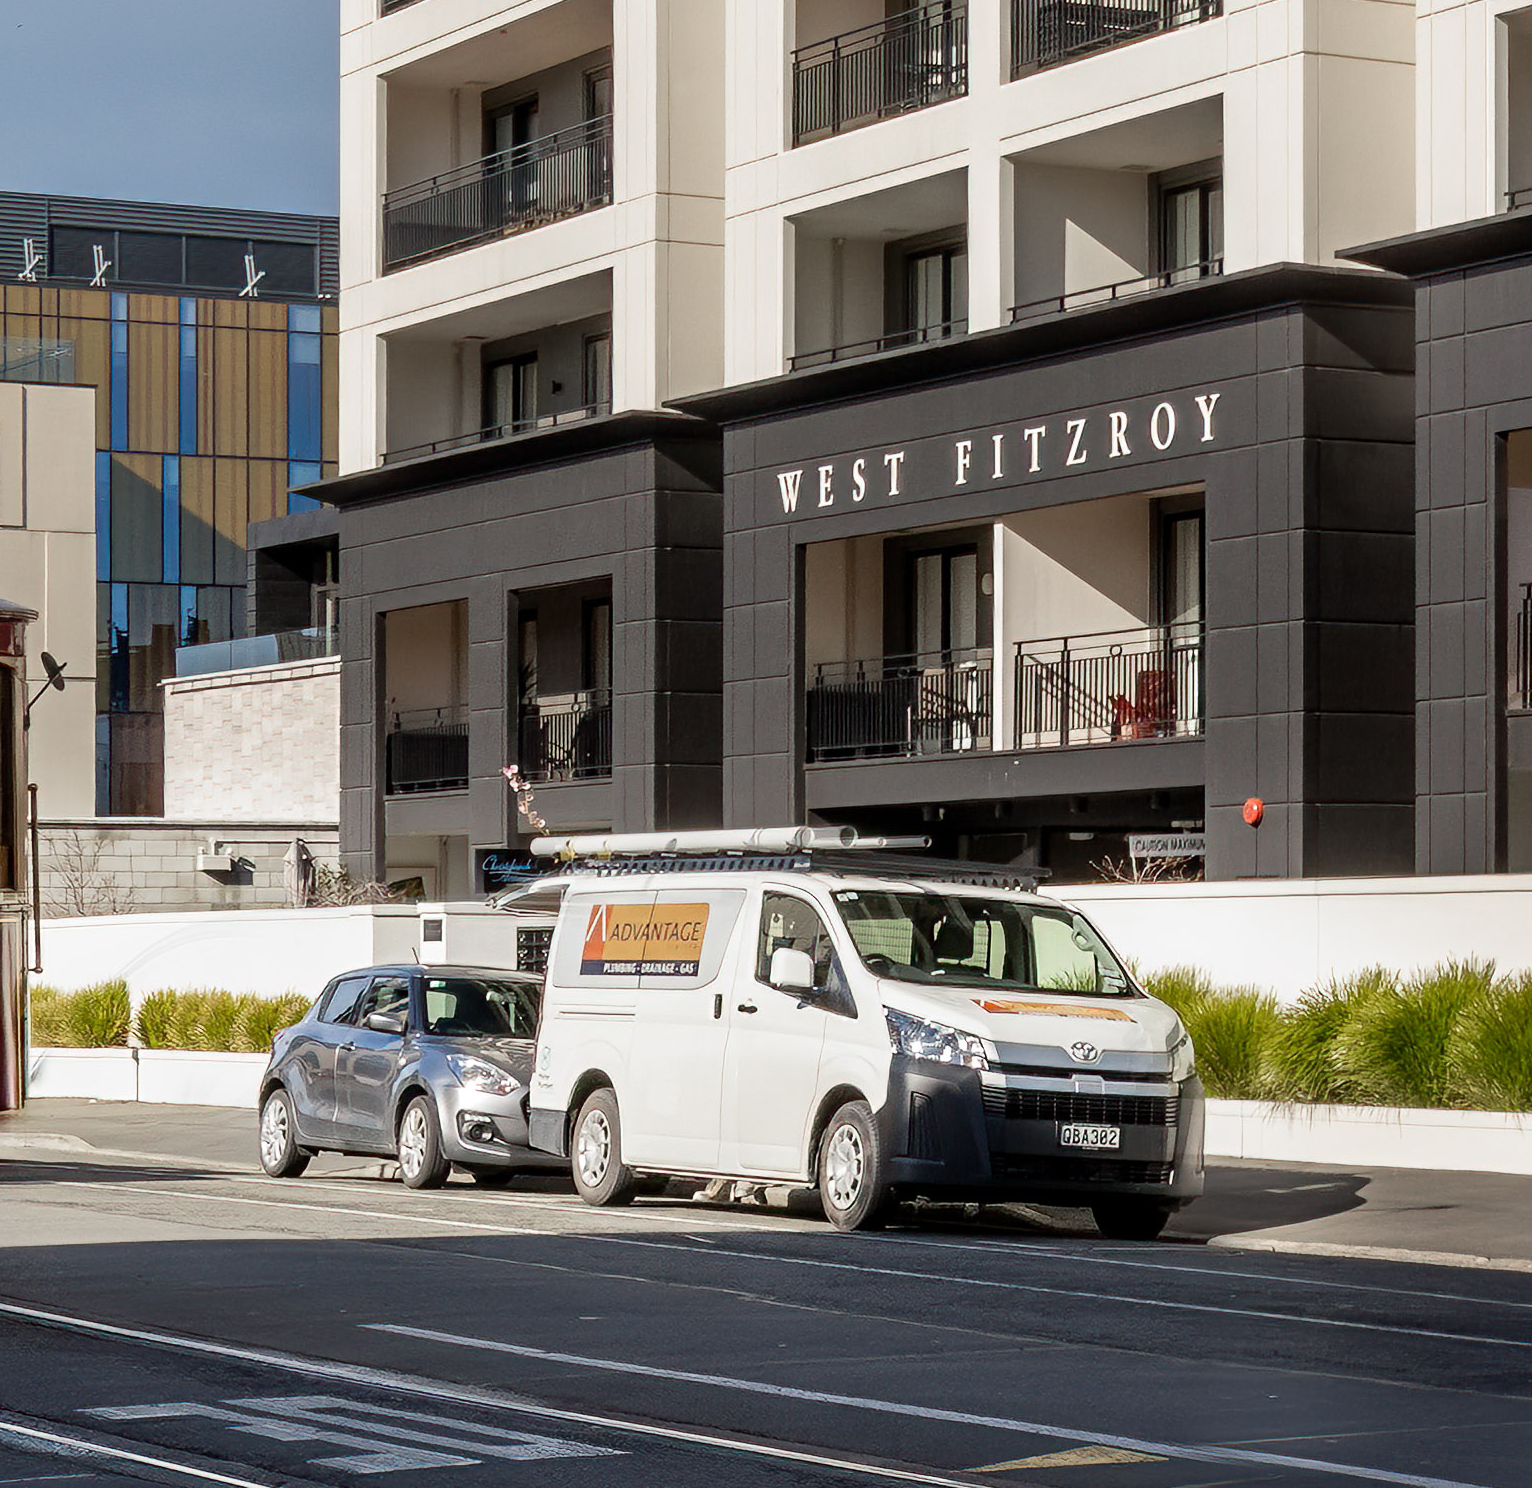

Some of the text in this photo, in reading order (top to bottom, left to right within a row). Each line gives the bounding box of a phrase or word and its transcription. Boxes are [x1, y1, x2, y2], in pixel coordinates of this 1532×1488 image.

[777, 392, 1221, 514] WEST FITZROY
[610, 922, 702, 942] ADVANTAGE
[680, 962, 694, 974] GAS
[1062, 1128, 1118, 1146] QBA302
